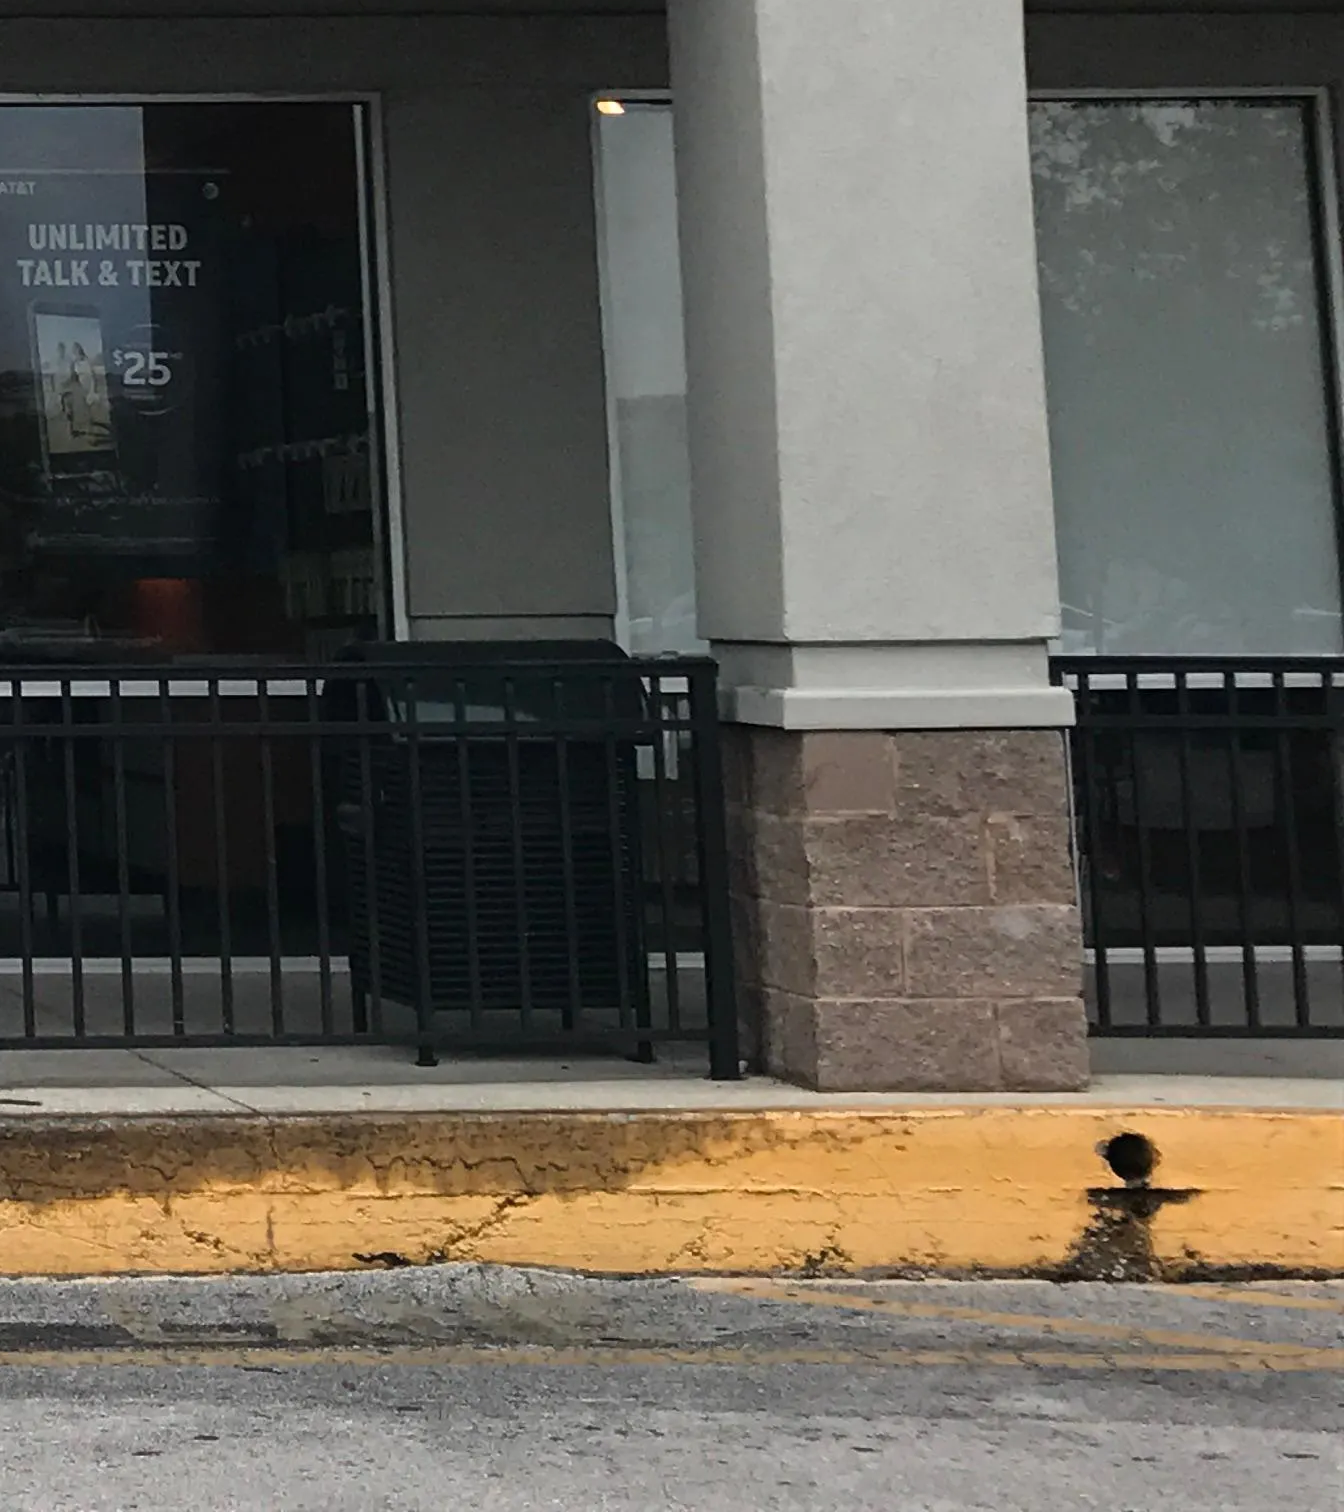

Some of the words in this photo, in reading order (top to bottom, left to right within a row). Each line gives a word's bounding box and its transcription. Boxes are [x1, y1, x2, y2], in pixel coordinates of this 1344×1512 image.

[28, 224, 188, 251] UNLIMITED
[17, 260, 90, 287] TALK
[98, 260, 119, 287] &
[126, 260, 201, 287] TEXT
